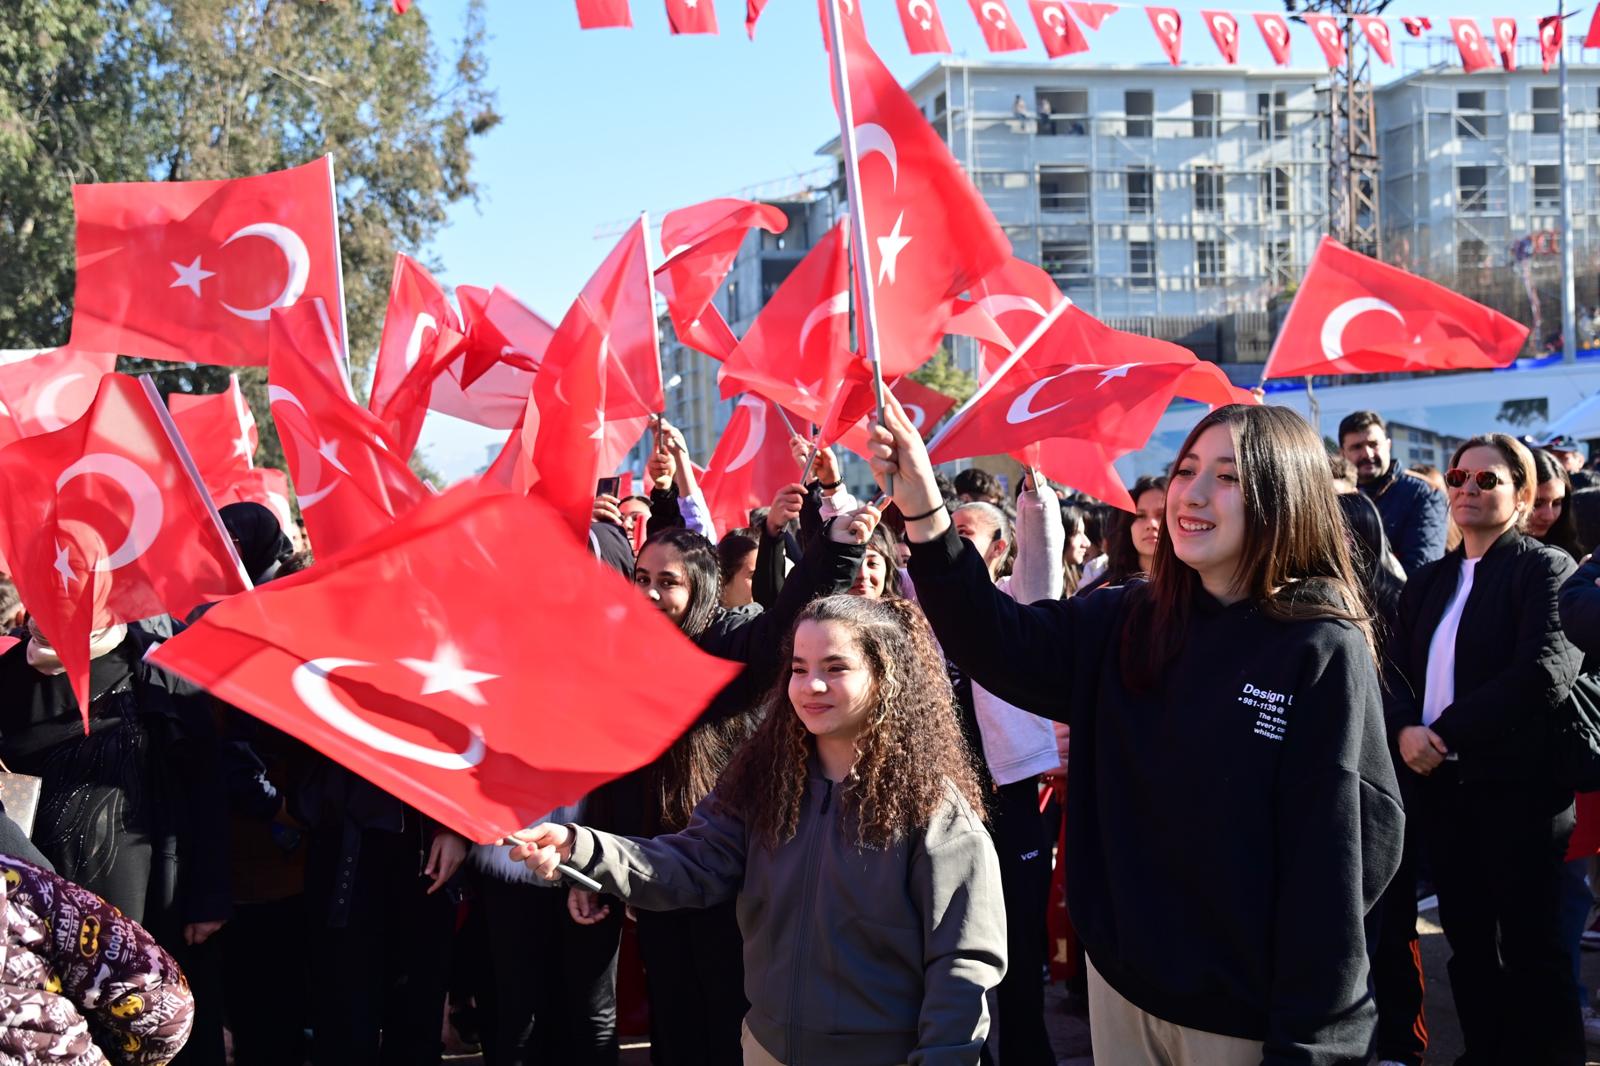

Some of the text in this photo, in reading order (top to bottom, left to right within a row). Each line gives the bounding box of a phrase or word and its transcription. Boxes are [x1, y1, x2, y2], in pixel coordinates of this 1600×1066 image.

[1243, 683, 1285, 703] Design
[1259, 712, 1271, 721] The
[1256, 721, 1276, 731] every
[104, 924, 128, 961] GOOD
